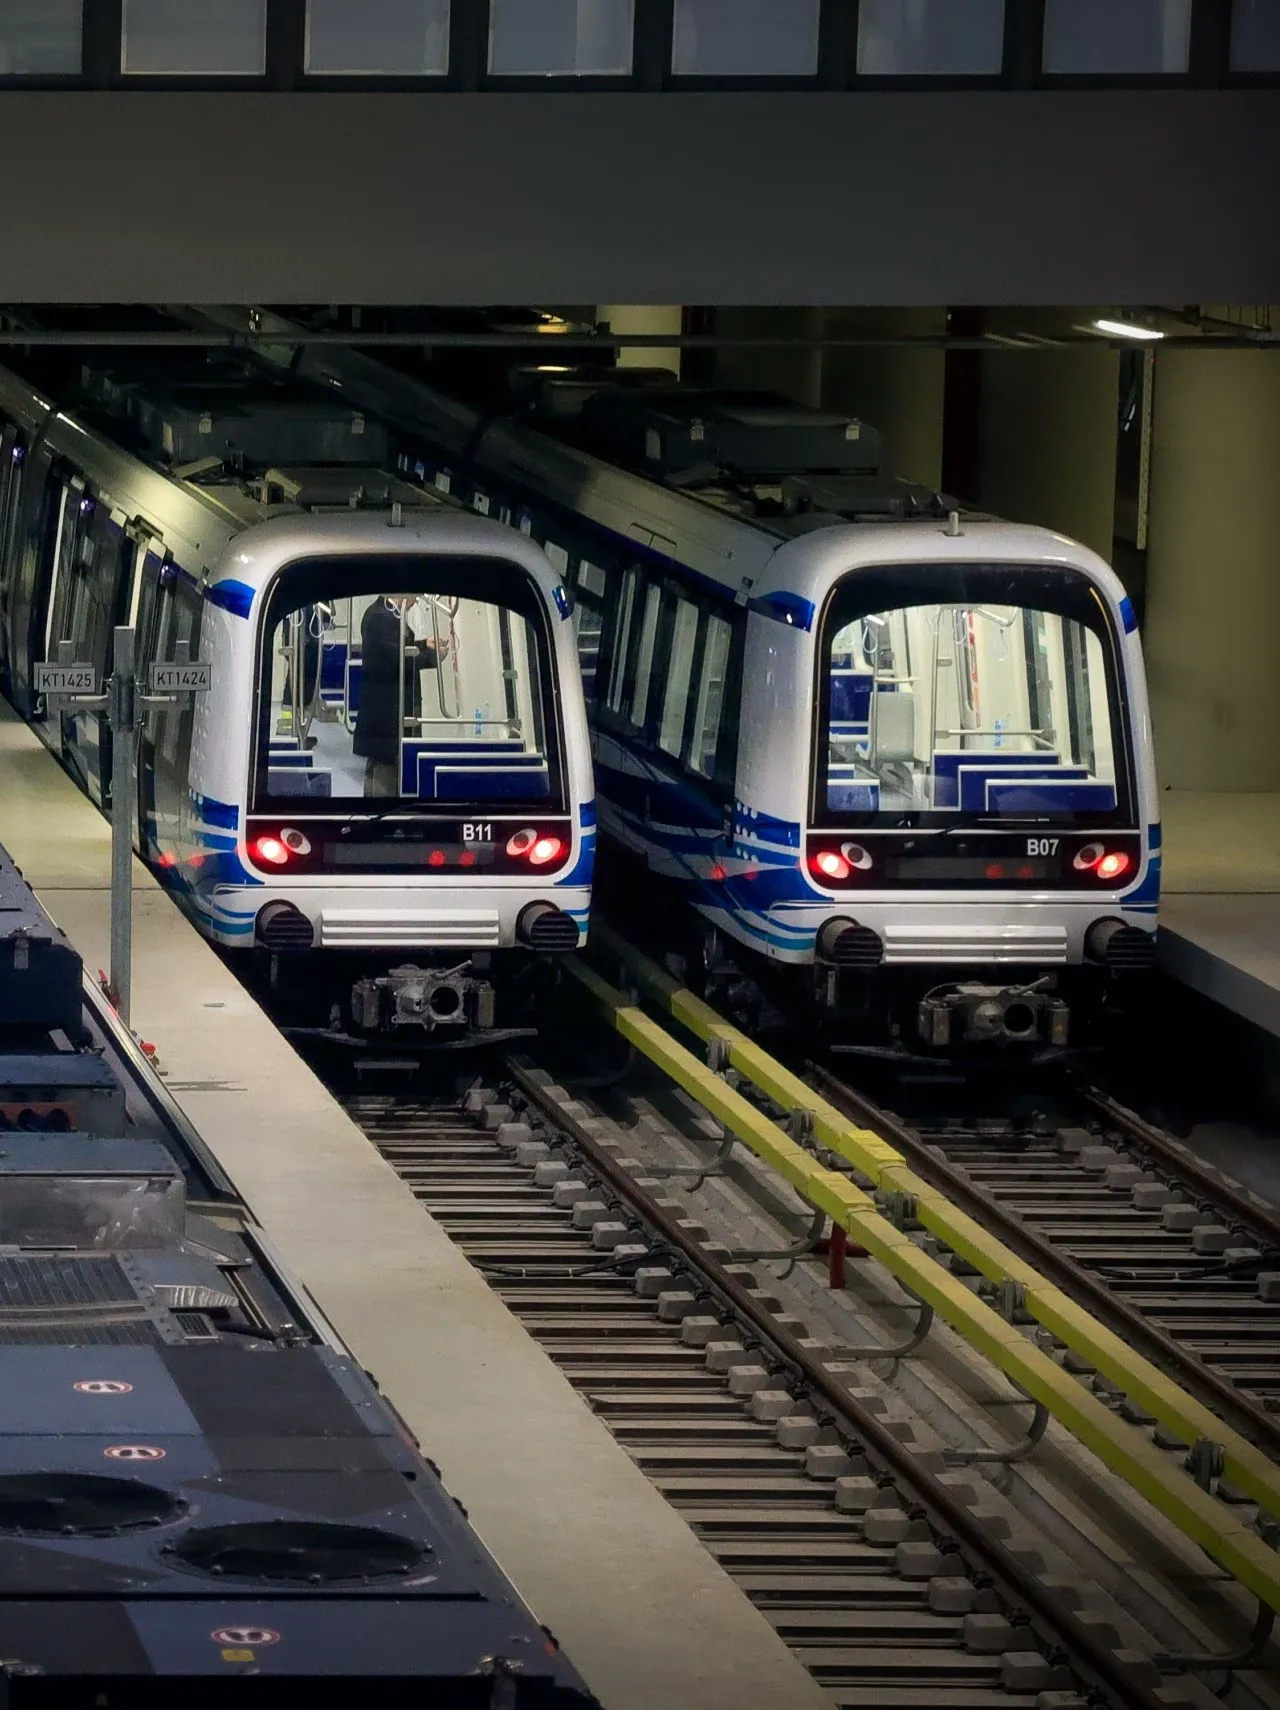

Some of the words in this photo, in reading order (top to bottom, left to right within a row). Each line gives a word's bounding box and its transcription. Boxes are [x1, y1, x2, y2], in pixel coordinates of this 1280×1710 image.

[42, 673, 92, 688] KT1425
[156, 671, 207, 686] KT1424
[462, 823, 492, 841] B11
[1026, 838, 1060, 856] B07
